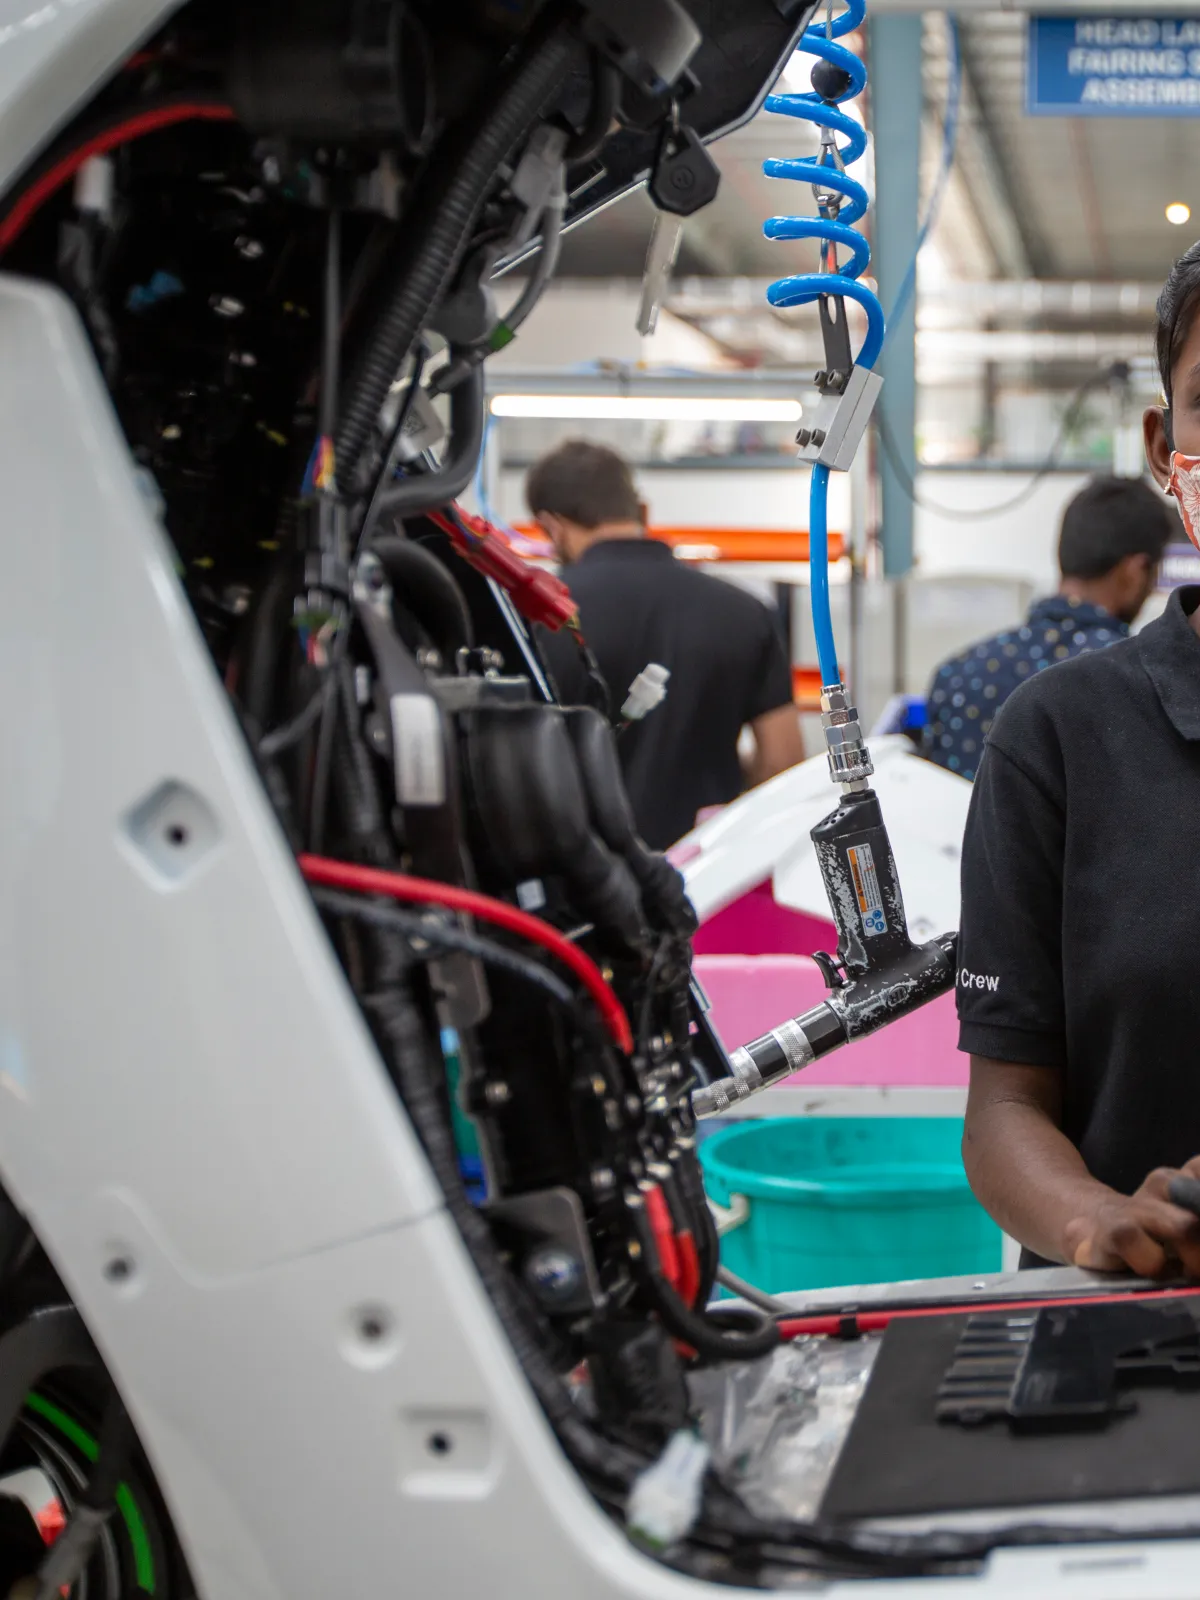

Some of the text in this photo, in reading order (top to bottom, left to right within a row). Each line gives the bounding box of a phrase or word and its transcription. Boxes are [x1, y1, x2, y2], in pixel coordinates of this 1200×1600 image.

[1075, 19, 1160, 46] HEAD
[1067, 48, 1186, 76] FAIRING
[961, 968, 1000, 991] Crew
